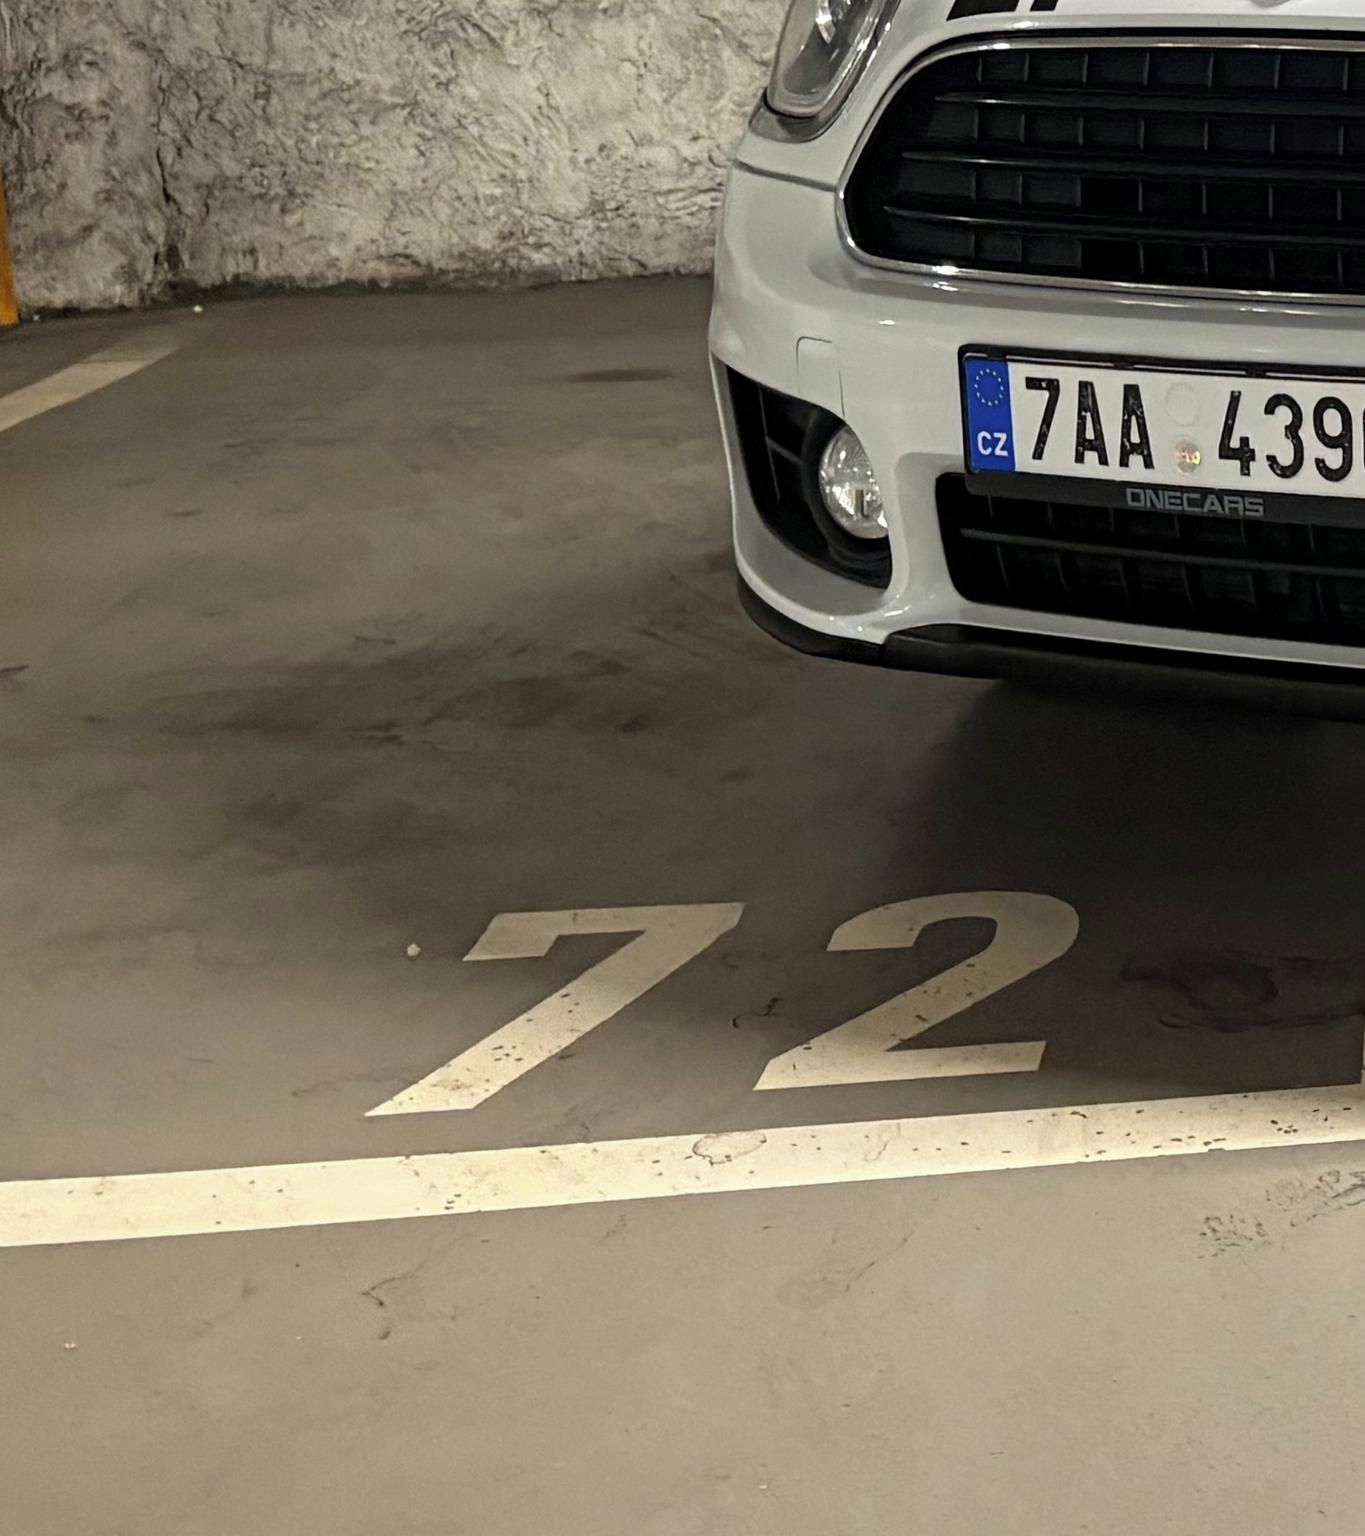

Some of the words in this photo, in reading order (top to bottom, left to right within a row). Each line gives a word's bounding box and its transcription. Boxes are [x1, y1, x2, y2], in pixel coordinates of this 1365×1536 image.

[977, 430, 1008, 456] CZ
[1025, 377, 1154, 469] 7AA
[1126, 488, 1264, 517] ONECARS
[365, 891, 1080, 1117] 72
